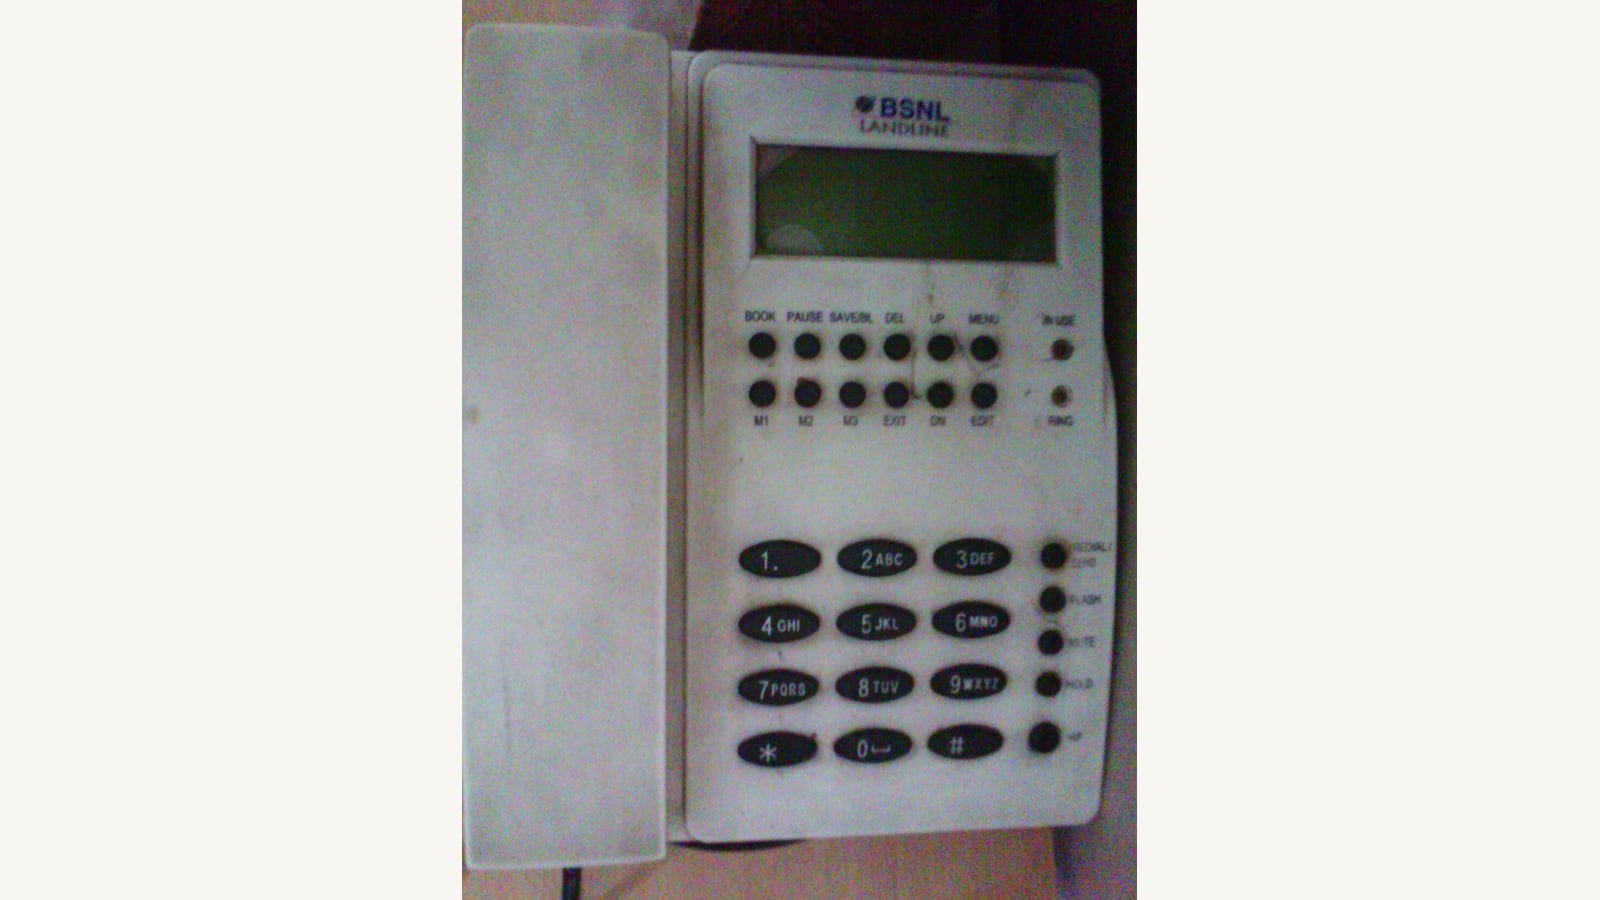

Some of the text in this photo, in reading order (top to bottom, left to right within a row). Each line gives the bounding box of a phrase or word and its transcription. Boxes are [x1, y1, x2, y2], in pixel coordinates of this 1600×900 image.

[880, 97, 950, 122] BSNL
[860, 119, 948, 138] LANDLINE
[745, 311, 776, 322] BOOK
[787, 312, 823, 323] PAUSE
[885, 313, 904, 324] DEL
[929, 313, 945, 324] UP
[968, 313, 999, 325] MENU
[754, 416, 769, 427] M1
[799, 416, 814, 427] M2
[843, 416, 858, 427] M3
[883, 416, 907, 427] EXIT
[970, 415, 995, 427] EDIT
[1048, 415, 1075, 427] RING
